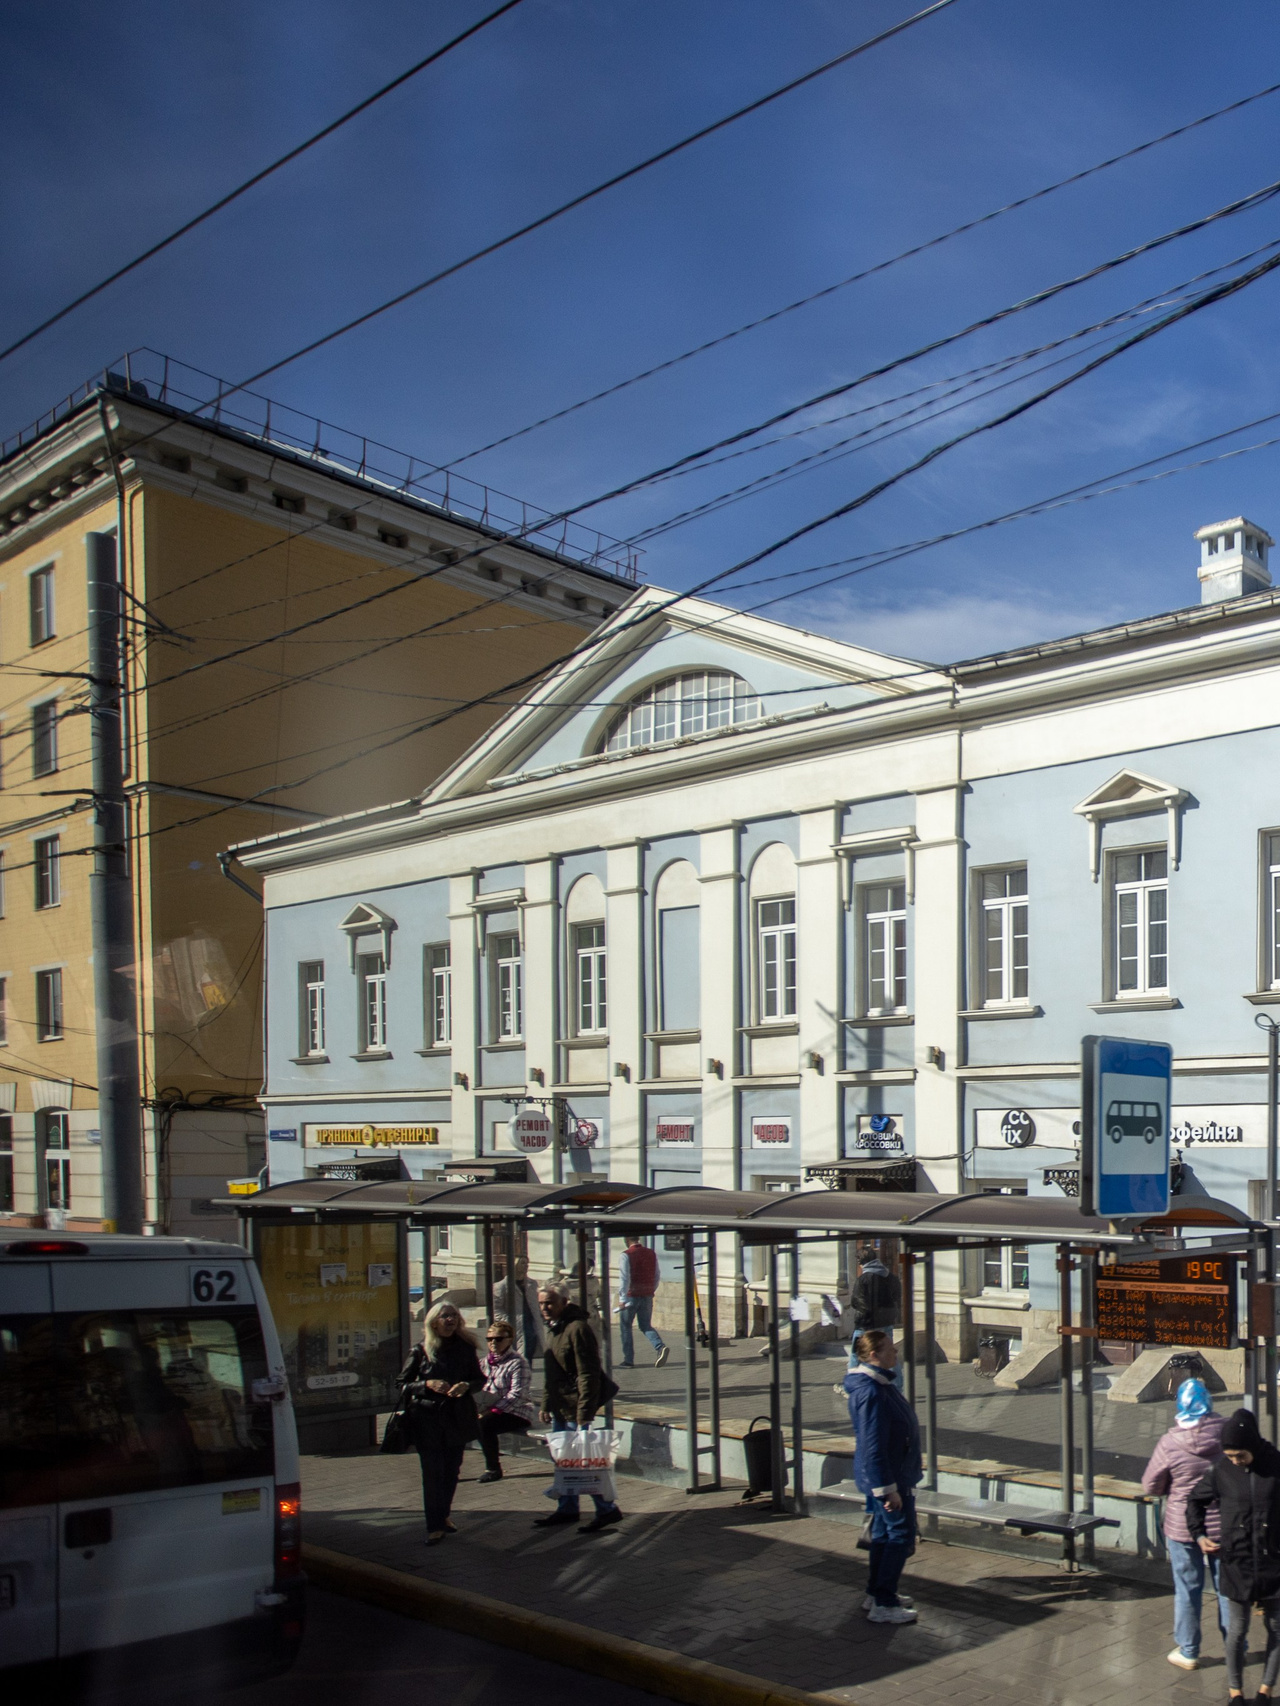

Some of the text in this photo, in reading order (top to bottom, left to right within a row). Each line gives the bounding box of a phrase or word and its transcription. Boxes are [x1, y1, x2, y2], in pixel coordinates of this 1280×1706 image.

[515, 1119, 550, 1131] РЕМОНТ
[656, 1124, 691, 1140] РЕМОНТ
[753, 1125, 785, 1141] ЧАСОВ
[315, 1128, 362, 1144] ПРЯНИКИ
[520, 1135, 547, 1148] ЧАСОВ
[1001, 1124, 1022, 1144] fix
[193, 1269, 237, 1303] 62
[555, 1457, 611, 1468] ФИСМА
